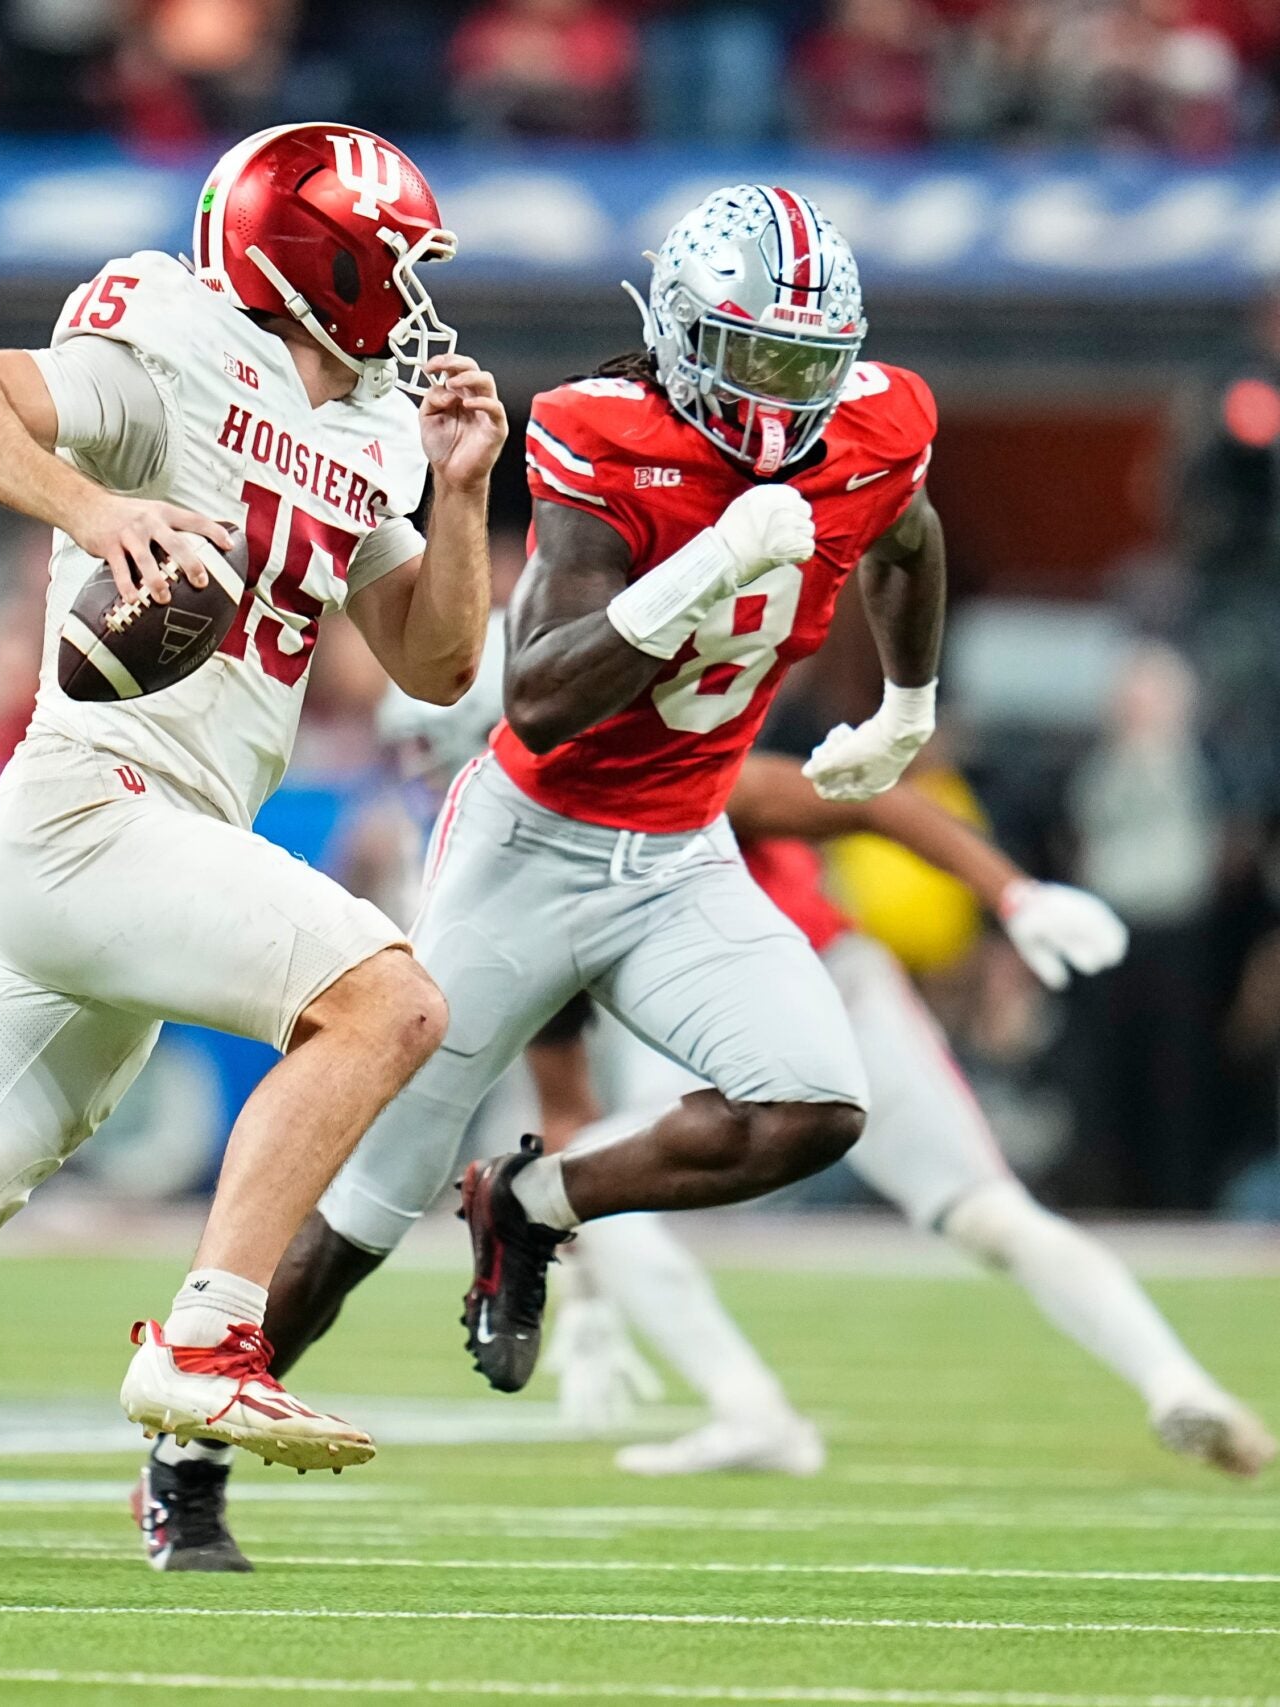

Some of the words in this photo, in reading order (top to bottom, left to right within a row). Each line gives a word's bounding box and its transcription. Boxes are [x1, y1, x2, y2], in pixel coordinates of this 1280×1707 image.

[68, 275, 140, 329] 15
[217, 403, 388, 529] HOOSIERS
[217, 479, 361, 688] 15
[651, 563, 804, 735] 8
